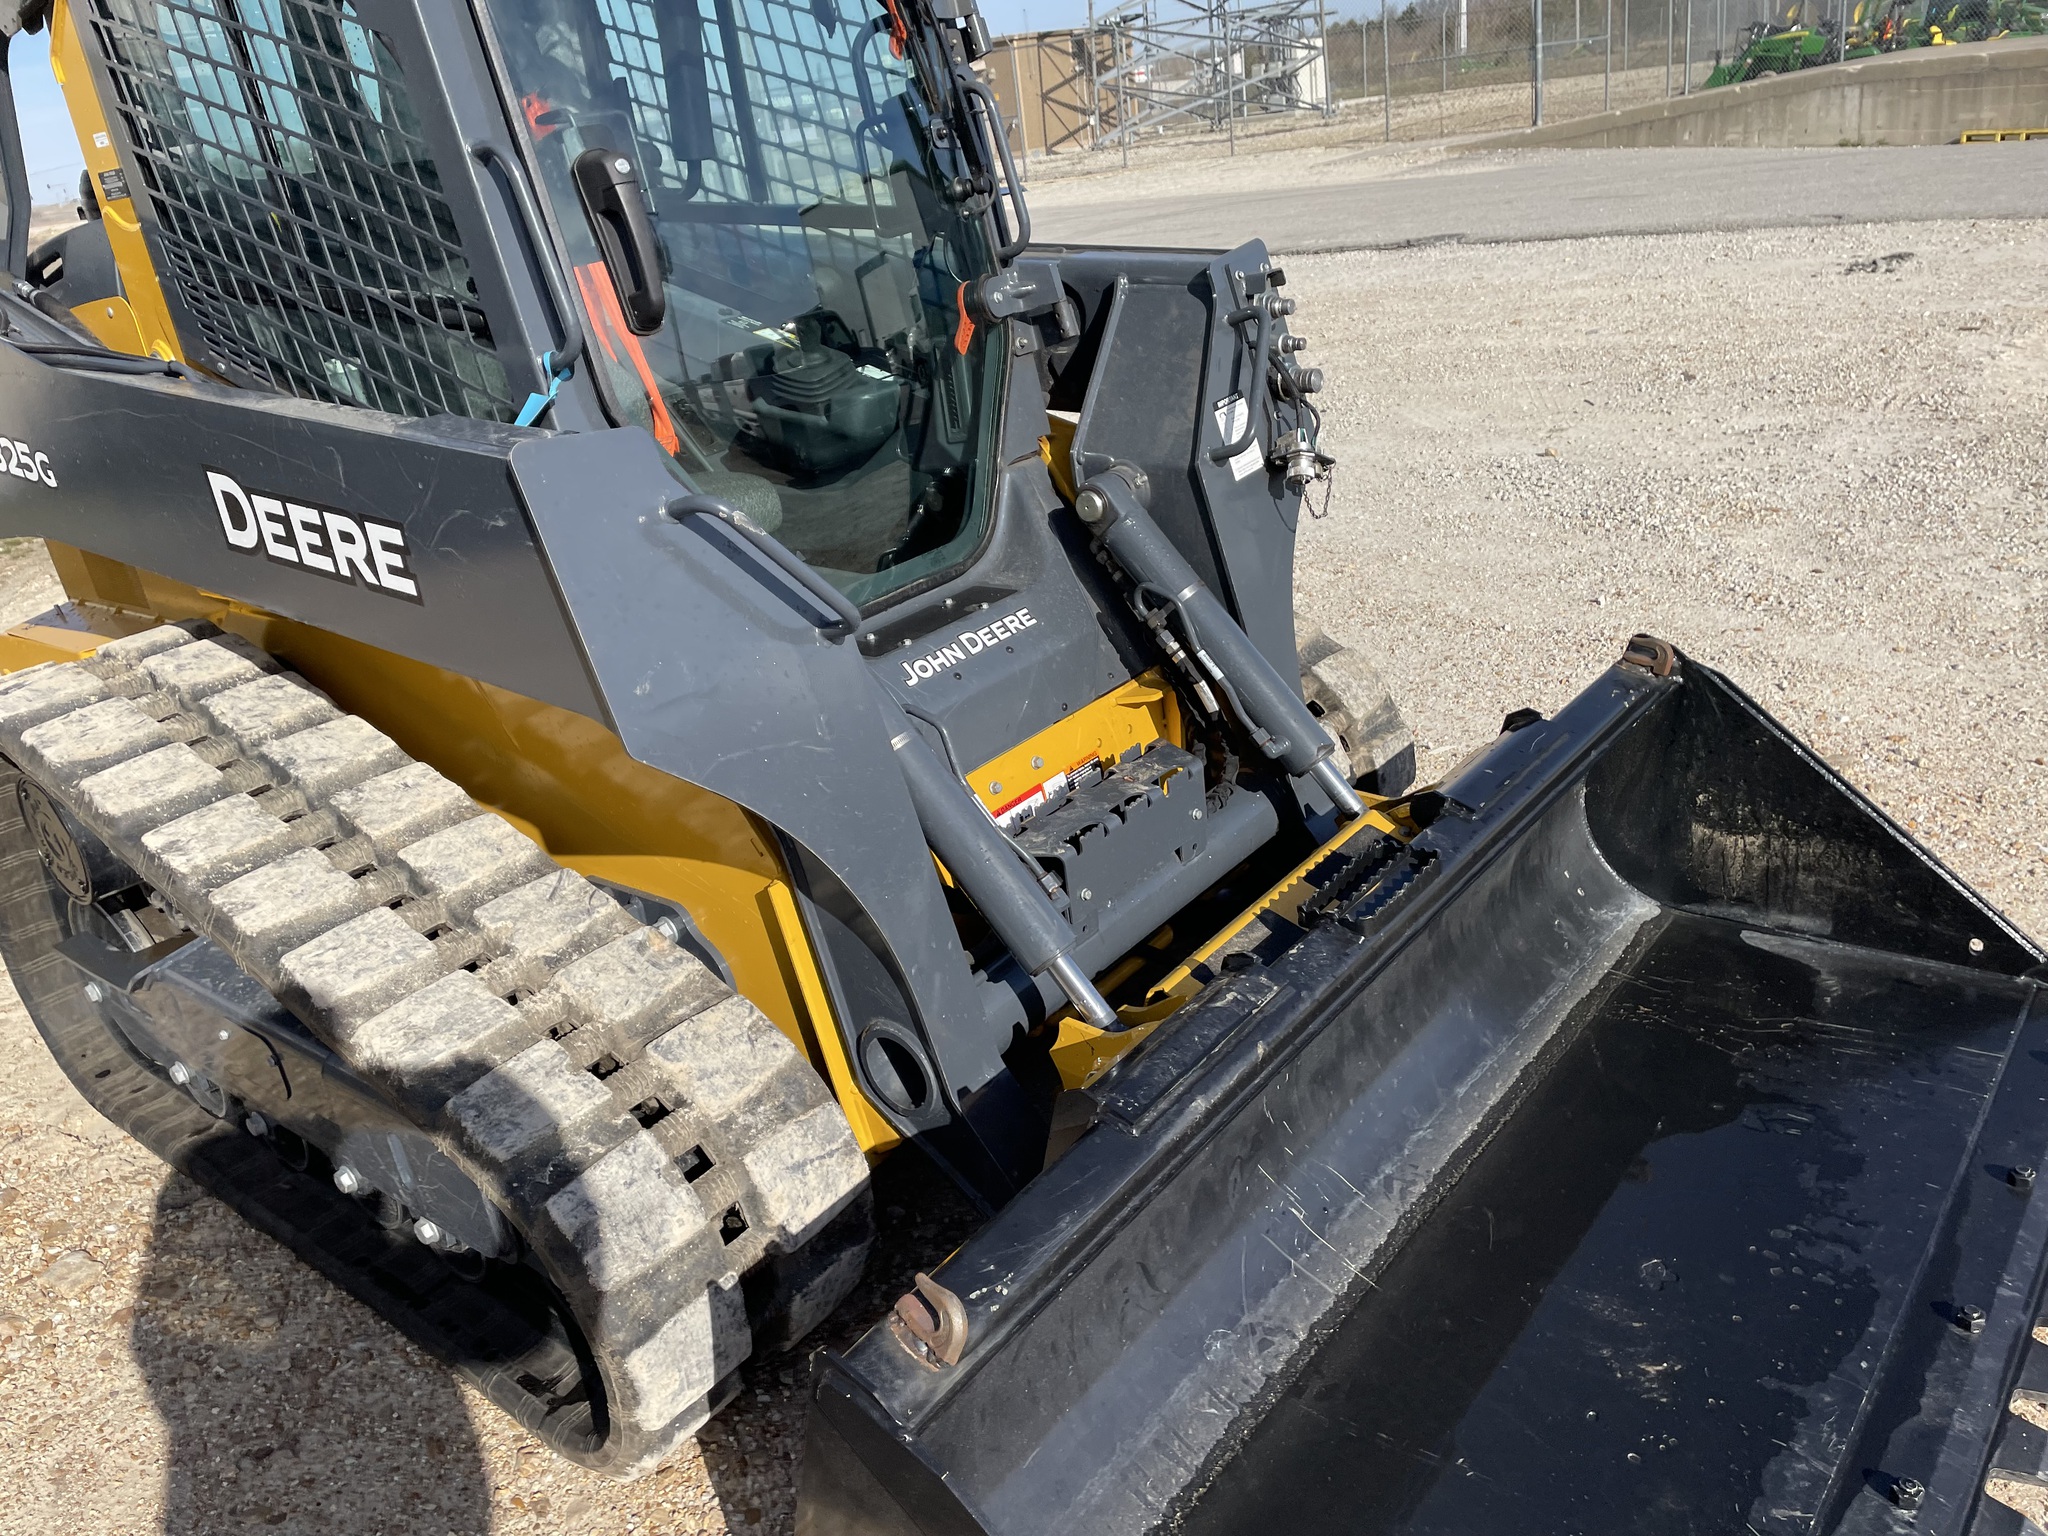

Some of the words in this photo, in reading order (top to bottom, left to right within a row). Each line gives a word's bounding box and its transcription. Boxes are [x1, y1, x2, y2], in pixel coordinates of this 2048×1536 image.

[206, 470, 418, 597] DEERE
[900, 642, 967, 688] JOHN
[960, 607, 1037, 655] DEERE
